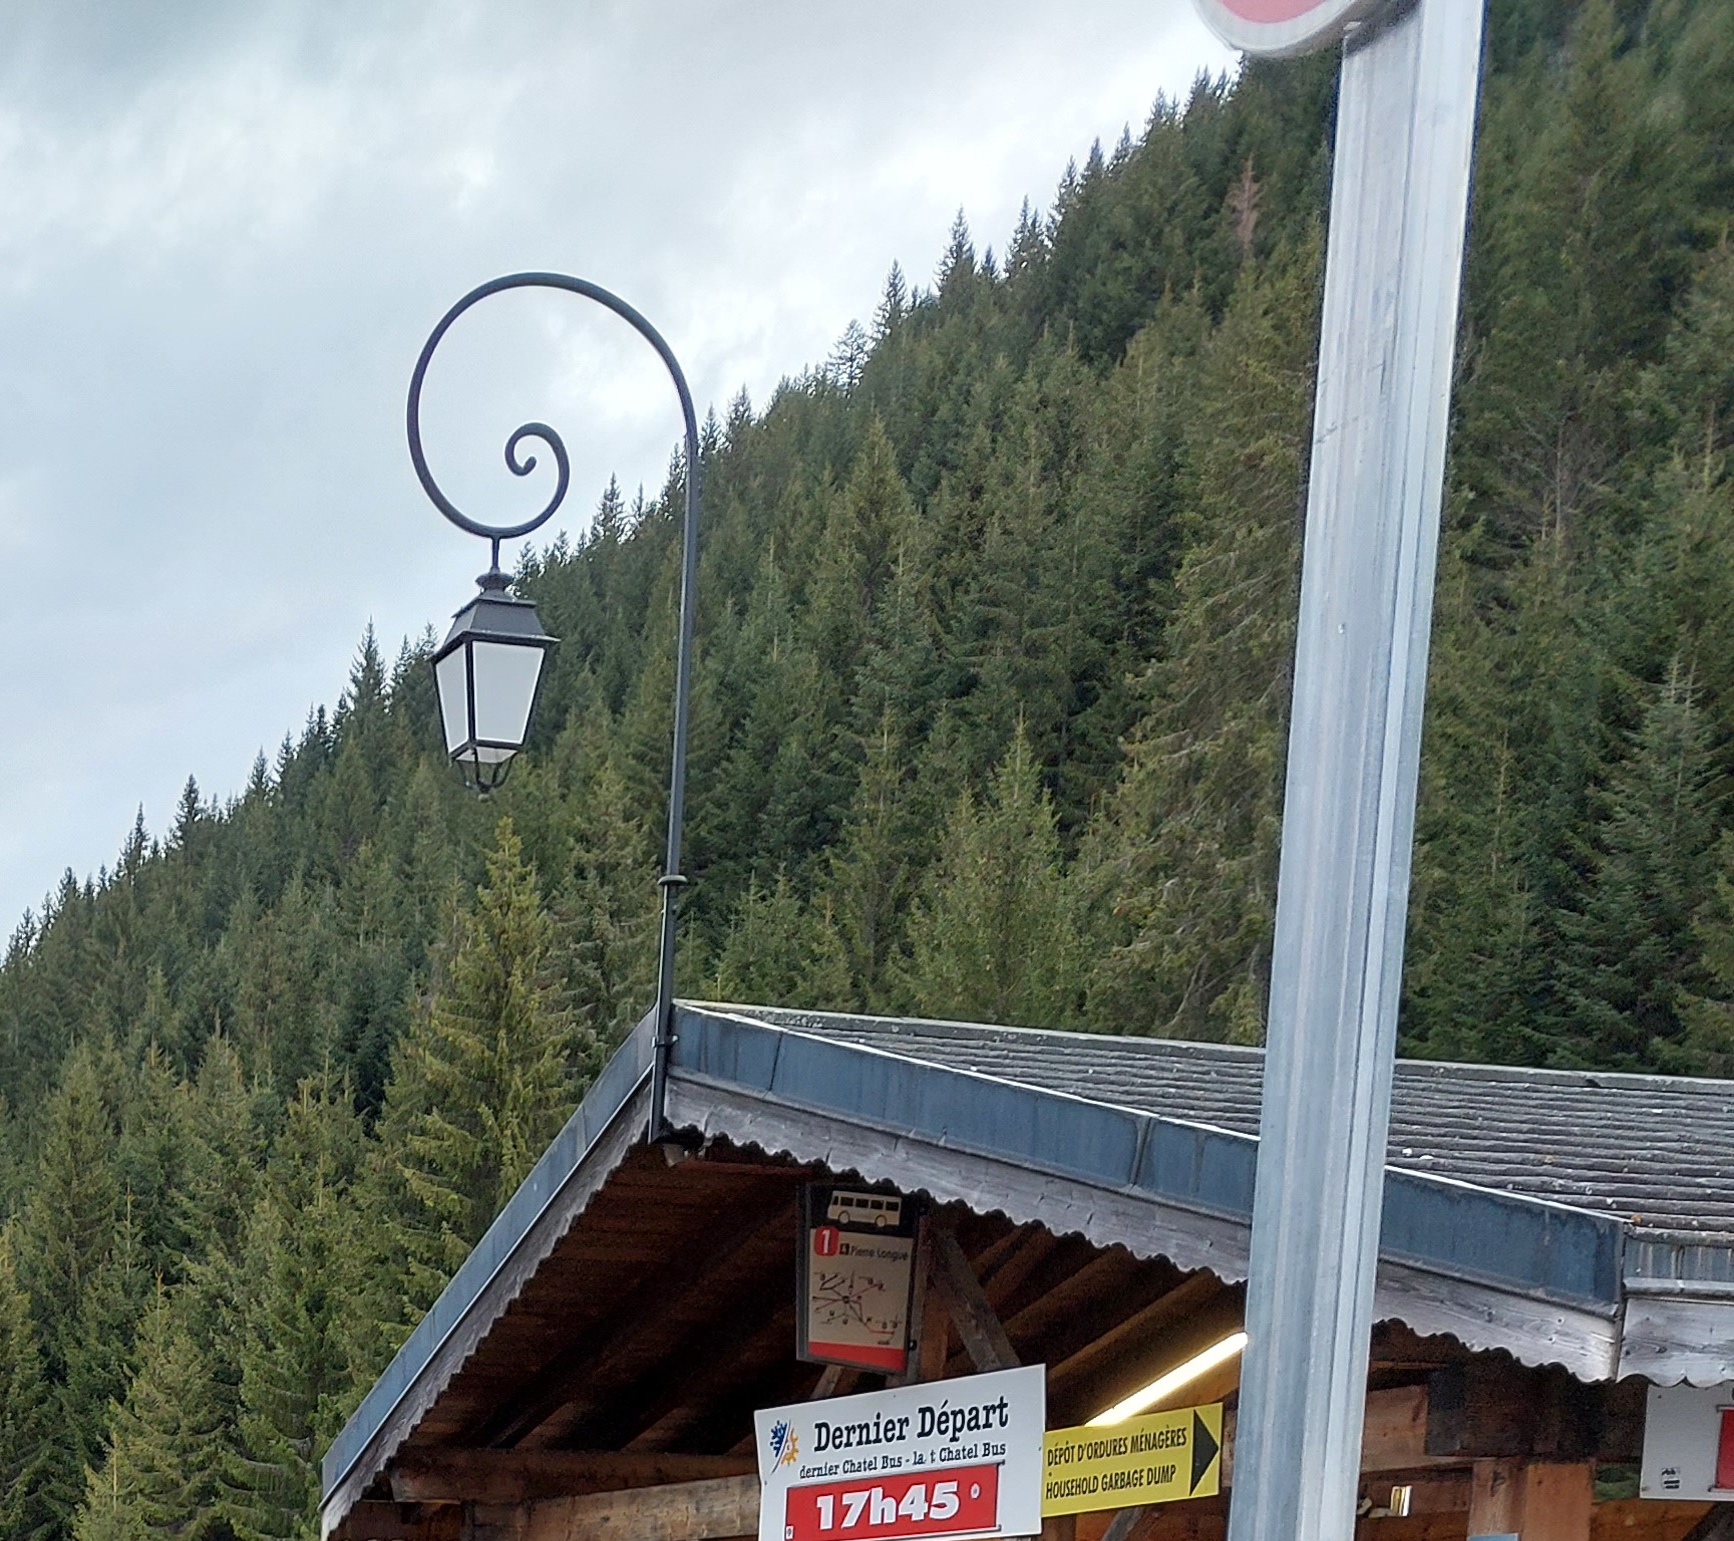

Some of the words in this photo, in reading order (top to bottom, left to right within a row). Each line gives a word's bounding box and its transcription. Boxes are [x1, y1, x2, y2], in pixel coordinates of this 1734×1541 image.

[821, 1229, 830, 1254] 1
[814, 1412, 909, 1452] Dernier
[916, 1396, 1009, 1443] Départ
[799, 1459, 840, 1479] dernier
[843, 1453, 877, 1474] Chatel
[881, 1450, 903, 1470] Bus
[913, 1449, 936, 1466] lat
[939, 1443, 978, 1463] Chatel
[982, 1442, 1006, 1458] Bus
[1047, 1440, 1076, 1467] DÉPÔT
[1078, 1436, 1127, 1463] D'ORDURES
[1130, 1425, 1187, 1454] MÉNAGÈRES
[1046, 1475, 1099, 1500] HOUSEHOLD
[1101, 1468, 1144, 1490] GARBAGE
[1146, 1464, 1177, 1486] DUMP
[816, 1480, 960, 1530] 17h45
